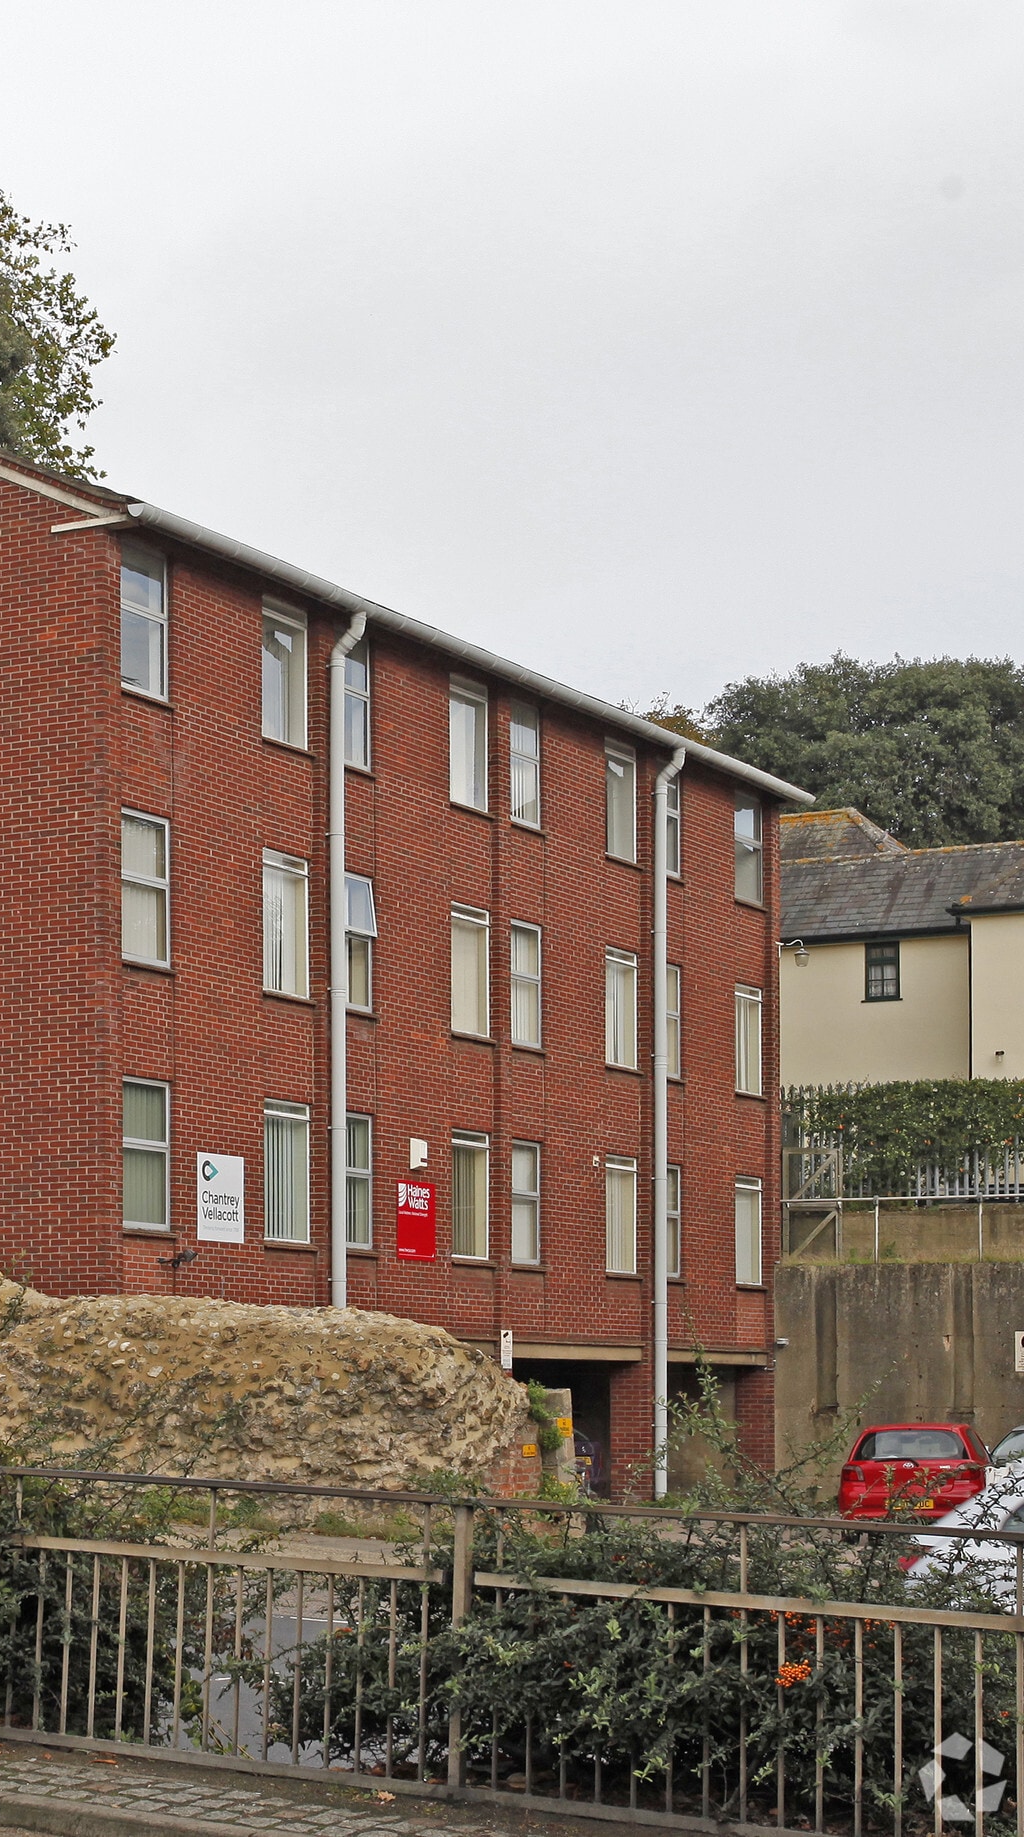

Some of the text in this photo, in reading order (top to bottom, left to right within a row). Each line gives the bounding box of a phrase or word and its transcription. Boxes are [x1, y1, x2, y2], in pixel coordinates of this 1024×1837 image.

[407, 1183, 430, 1198] Haines
[201, 1190, 240, 1209] Chantrey
[407, 1196, 429, 1210] Watts
[201, 1206, 239, 1222] Vellacott
